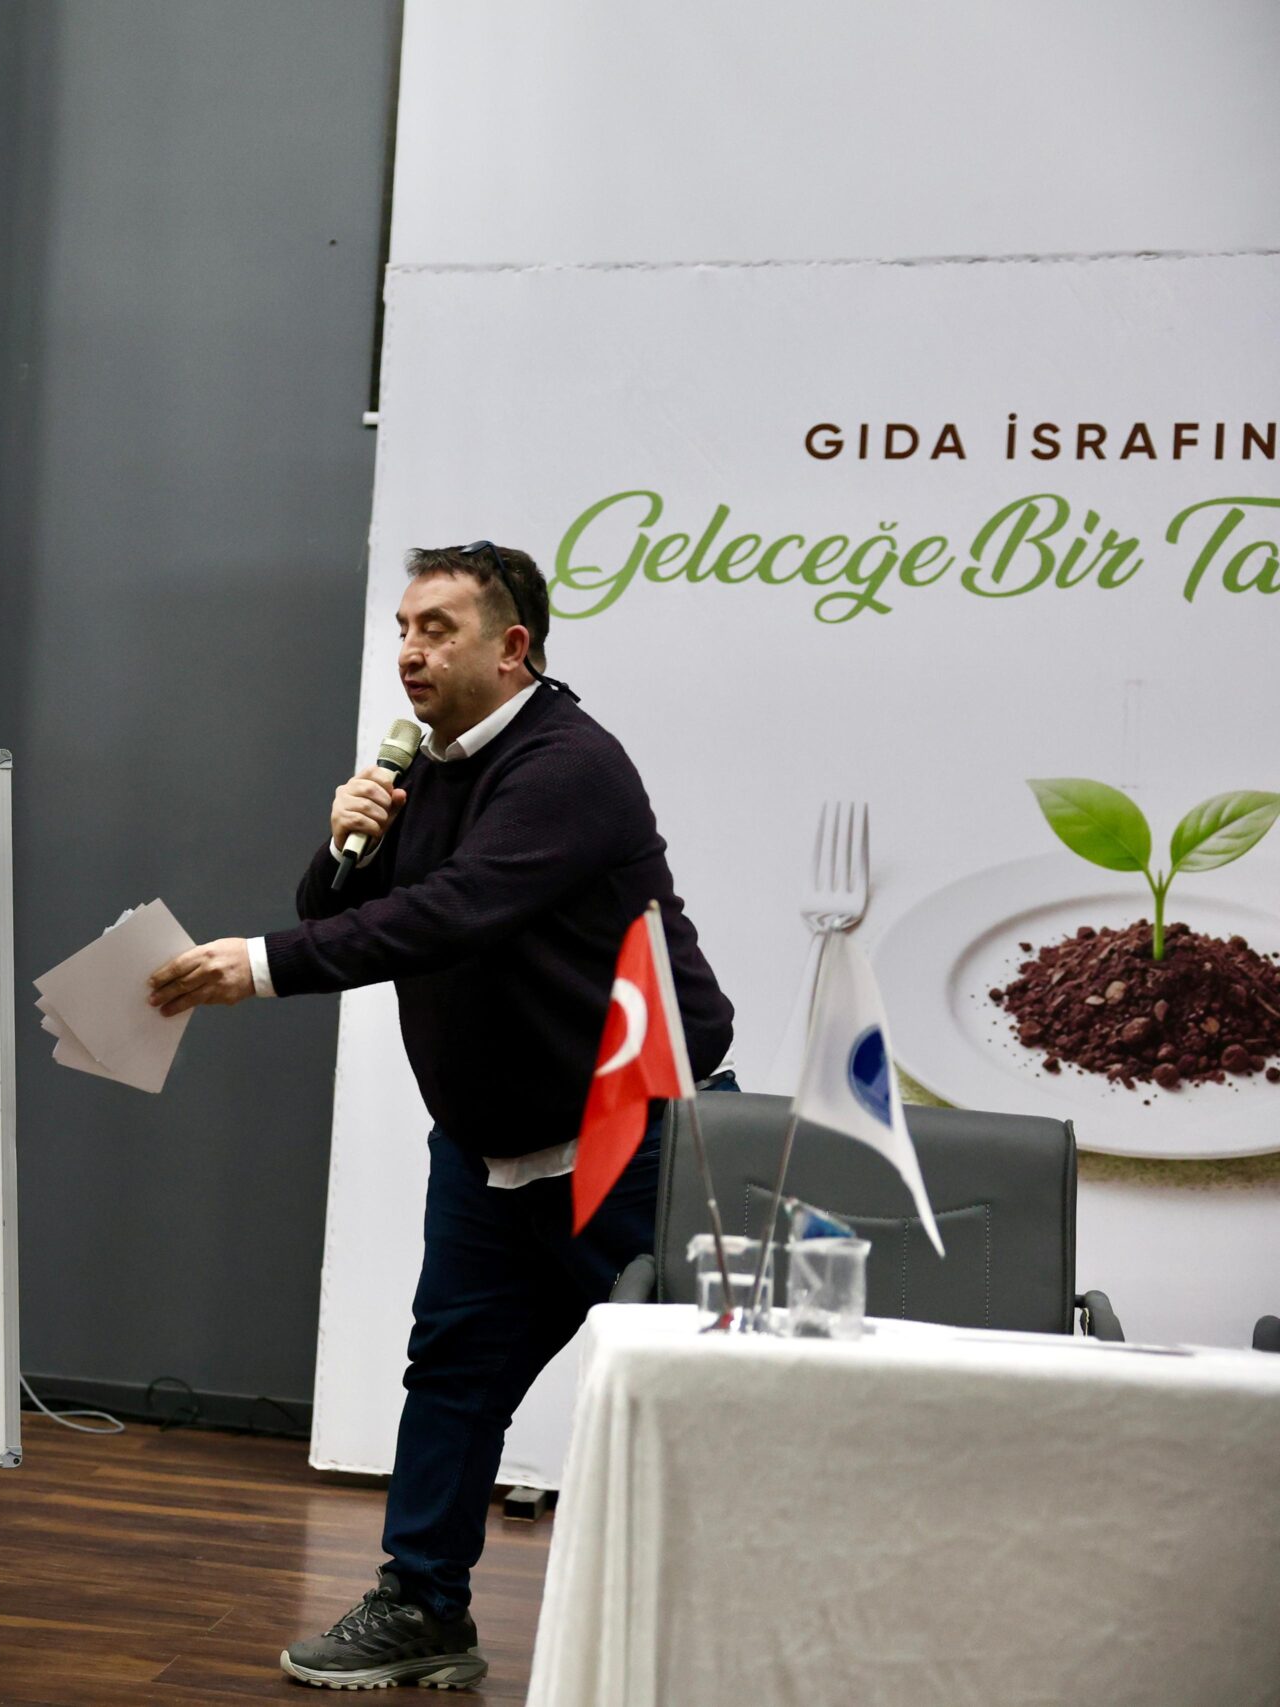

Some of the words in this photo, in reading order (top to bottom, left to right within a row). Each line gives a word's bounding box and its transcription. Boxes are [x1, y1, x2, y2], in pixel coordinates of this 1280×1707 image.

[804, 422, 967, 461] GIDA
[1006, 412, 1278, 461] İSRAFIN
[546, 490, 956, 624] Geleceğe
[961, 493, 1144, 598] Bir
[1166, 495, 1280, 604] Ta
